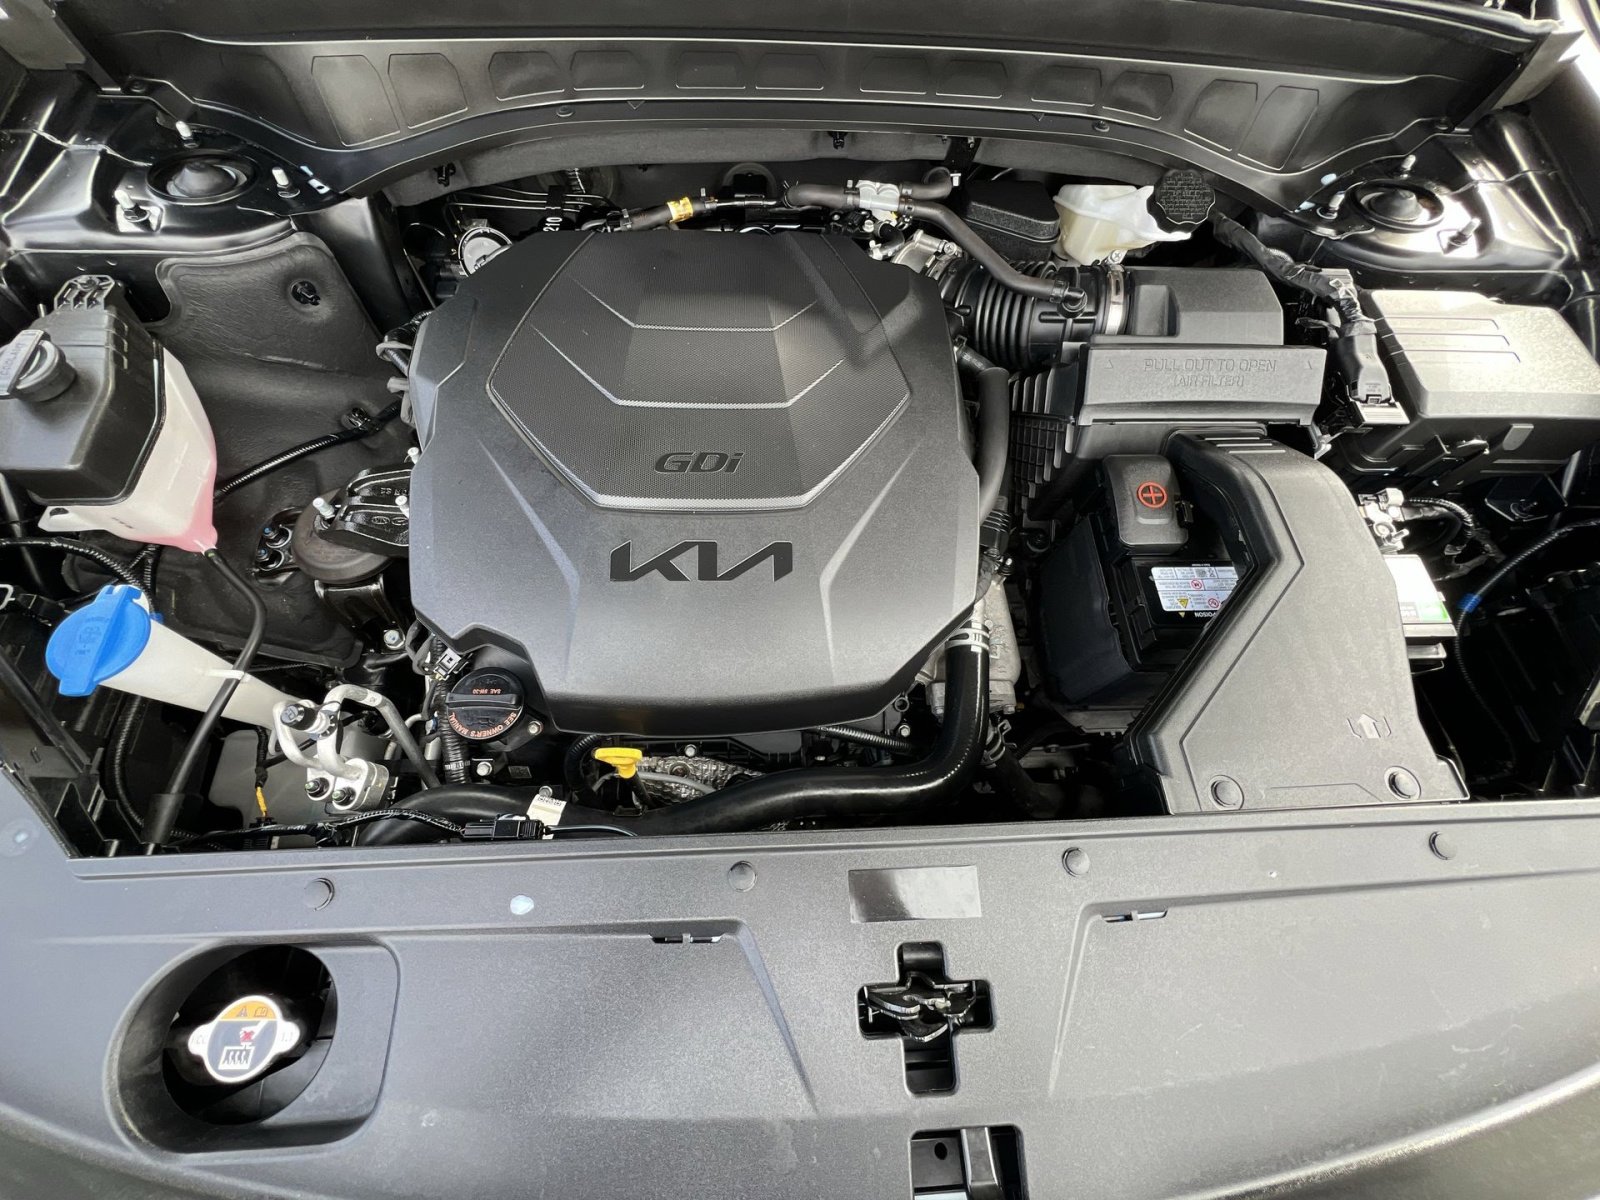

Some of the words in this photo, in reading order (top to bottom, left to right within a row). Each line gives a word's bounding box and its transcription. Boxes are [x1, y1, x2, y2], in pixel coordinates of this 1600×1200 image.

[1144, 358, 1181, 372] PULL
[1184, 358, 1214, 372] OUT
[1218, 358, 1235, 372] TO
[1239, 358, 1277, 372] OPEN
[1173, 374, 1198, 387] (AIR
[1200, 374, 1245, 387] FILTER)
[654, 451, 745, 474] GDi
[609, 539, 793, 582] KIA
[448, 711, 470, 736] MANUAL
[503, 711, 517, 726] SEE
[470, 724, 504, 738] OWNER'S
